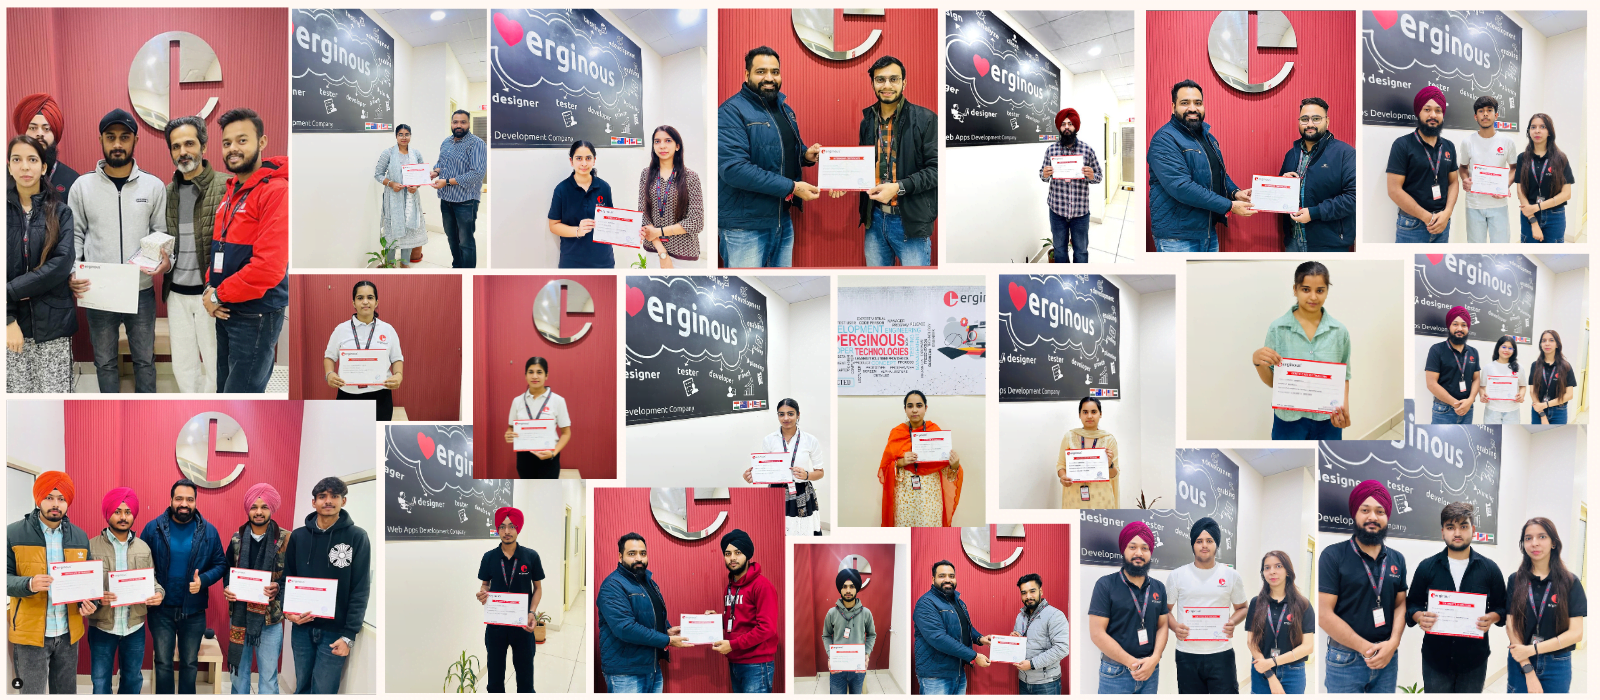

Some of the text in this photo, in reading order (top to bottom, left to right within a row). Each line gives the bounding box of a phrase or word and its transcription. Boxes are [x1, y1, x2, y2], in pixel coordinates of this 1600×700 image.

[977, 20, 1000, 40] analyze
[1400, 13, 1491, 69] erginous
[296, 25, 371, 76] erginous
[525, 30, 615, 87] erginous
[990, 64, 1043, 100] erginous
[1368, 75, 1412, 89] designer
[319, 87, 338, 98] tester
[491, 93, 539, 108] designer
[555, 98, 578, 110] tester
[587, 106, 612, 122] developer
[970, 108, 998, 119] designer
[1006, 110, 1020, 118] tester
[494, 131, 574, 143] Development Company
[955, 134, 970, 142] Apps
[1444, 254, 1512, 297] erginous
[1421, 298, 1453, 310] designer
[1464, 304, 1481, 313] tester
[1028, 292, 1095, 336] erginous
[647, 295, 738, 346] erginous
[840, 334, 905, 347] ERGINOUS
[854, 347, 909, 356] TECHNOLOGIES
[1007, 353, 1037, 365] designer
[1047, 354, 1064, 364] tester
[1071, 359, 1092, 372] developer
[677, 367, 699, 377] tester
[708, 370, 734, 384] developer
[1007, 386, 1041, 396] Development
[1041, 388, 1061, 396] Company
[669, 405, 695, 413] Company
[1387, 479, 1414, 495] tester
[417, 498, 445, 509] designer
[454, 500, 469, 508] tester
[1080, 511, 1125, 527] designer
[387, 525, 403, 534] Web
[403, 526, 419, 535] Apps
[419, 526, 450, 535] Development
